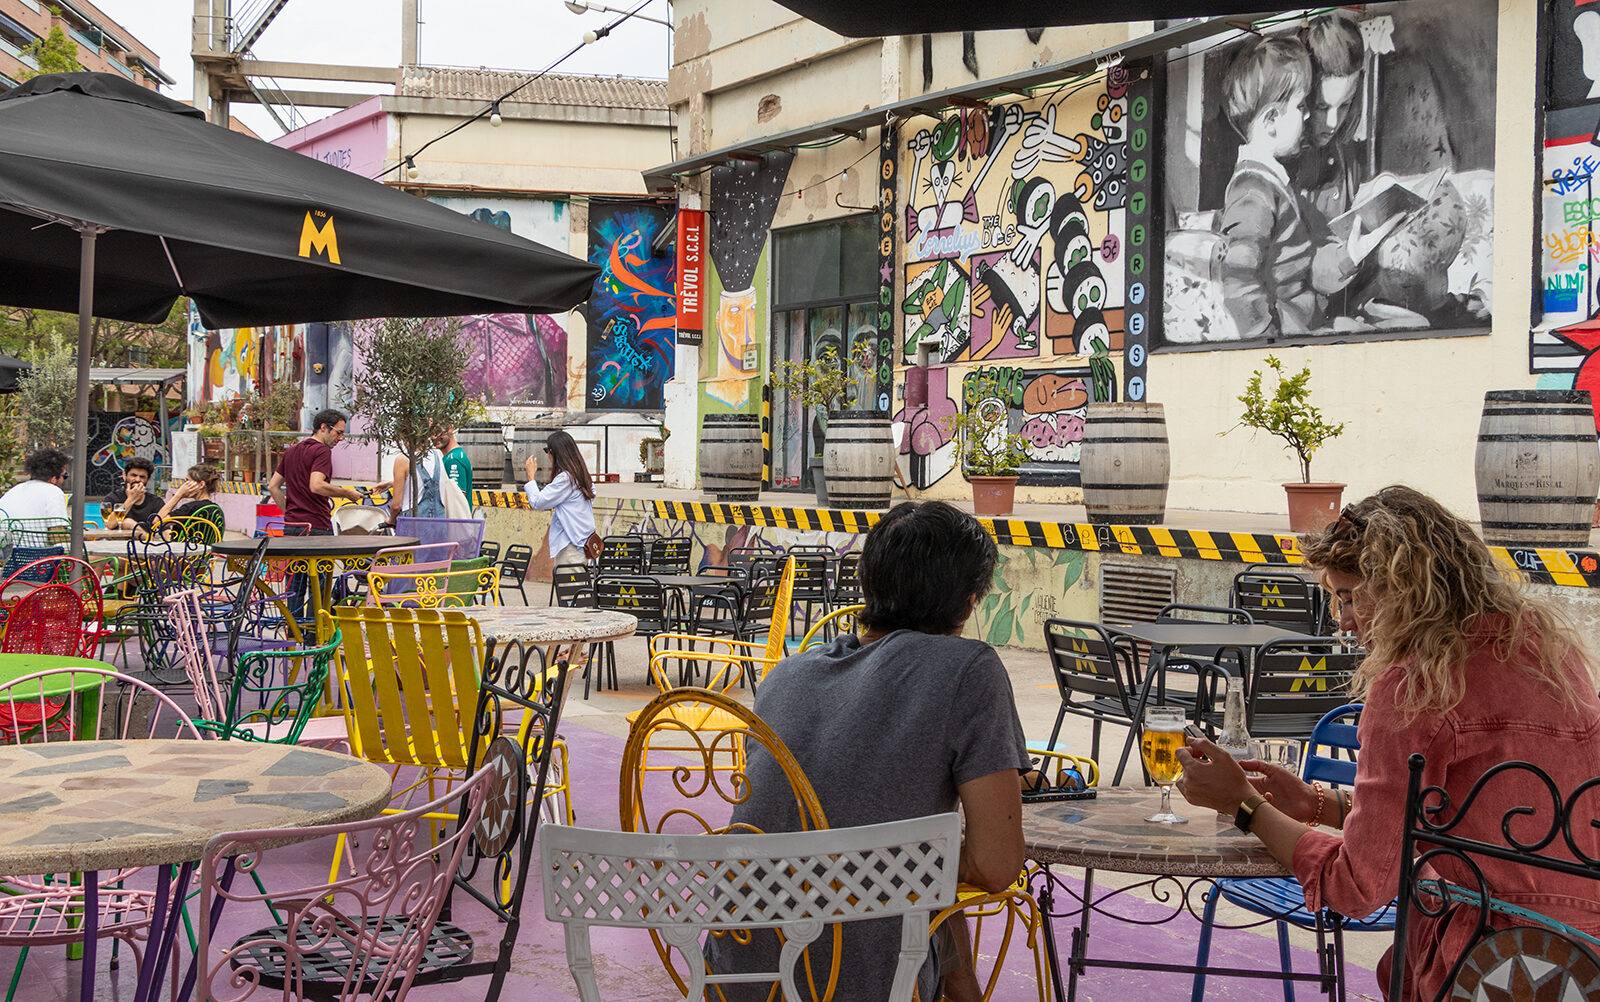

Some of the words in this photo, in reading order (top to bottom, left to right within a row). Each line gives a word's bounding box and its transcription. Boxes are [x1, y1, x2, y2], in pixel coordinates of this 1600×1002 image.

[298, 210, 342, 265] M
[915, 221, 982, 263] Cornelius
[982, 216, 1000, 227] THE
[680, 267, 699, 314] TRÈVOL
